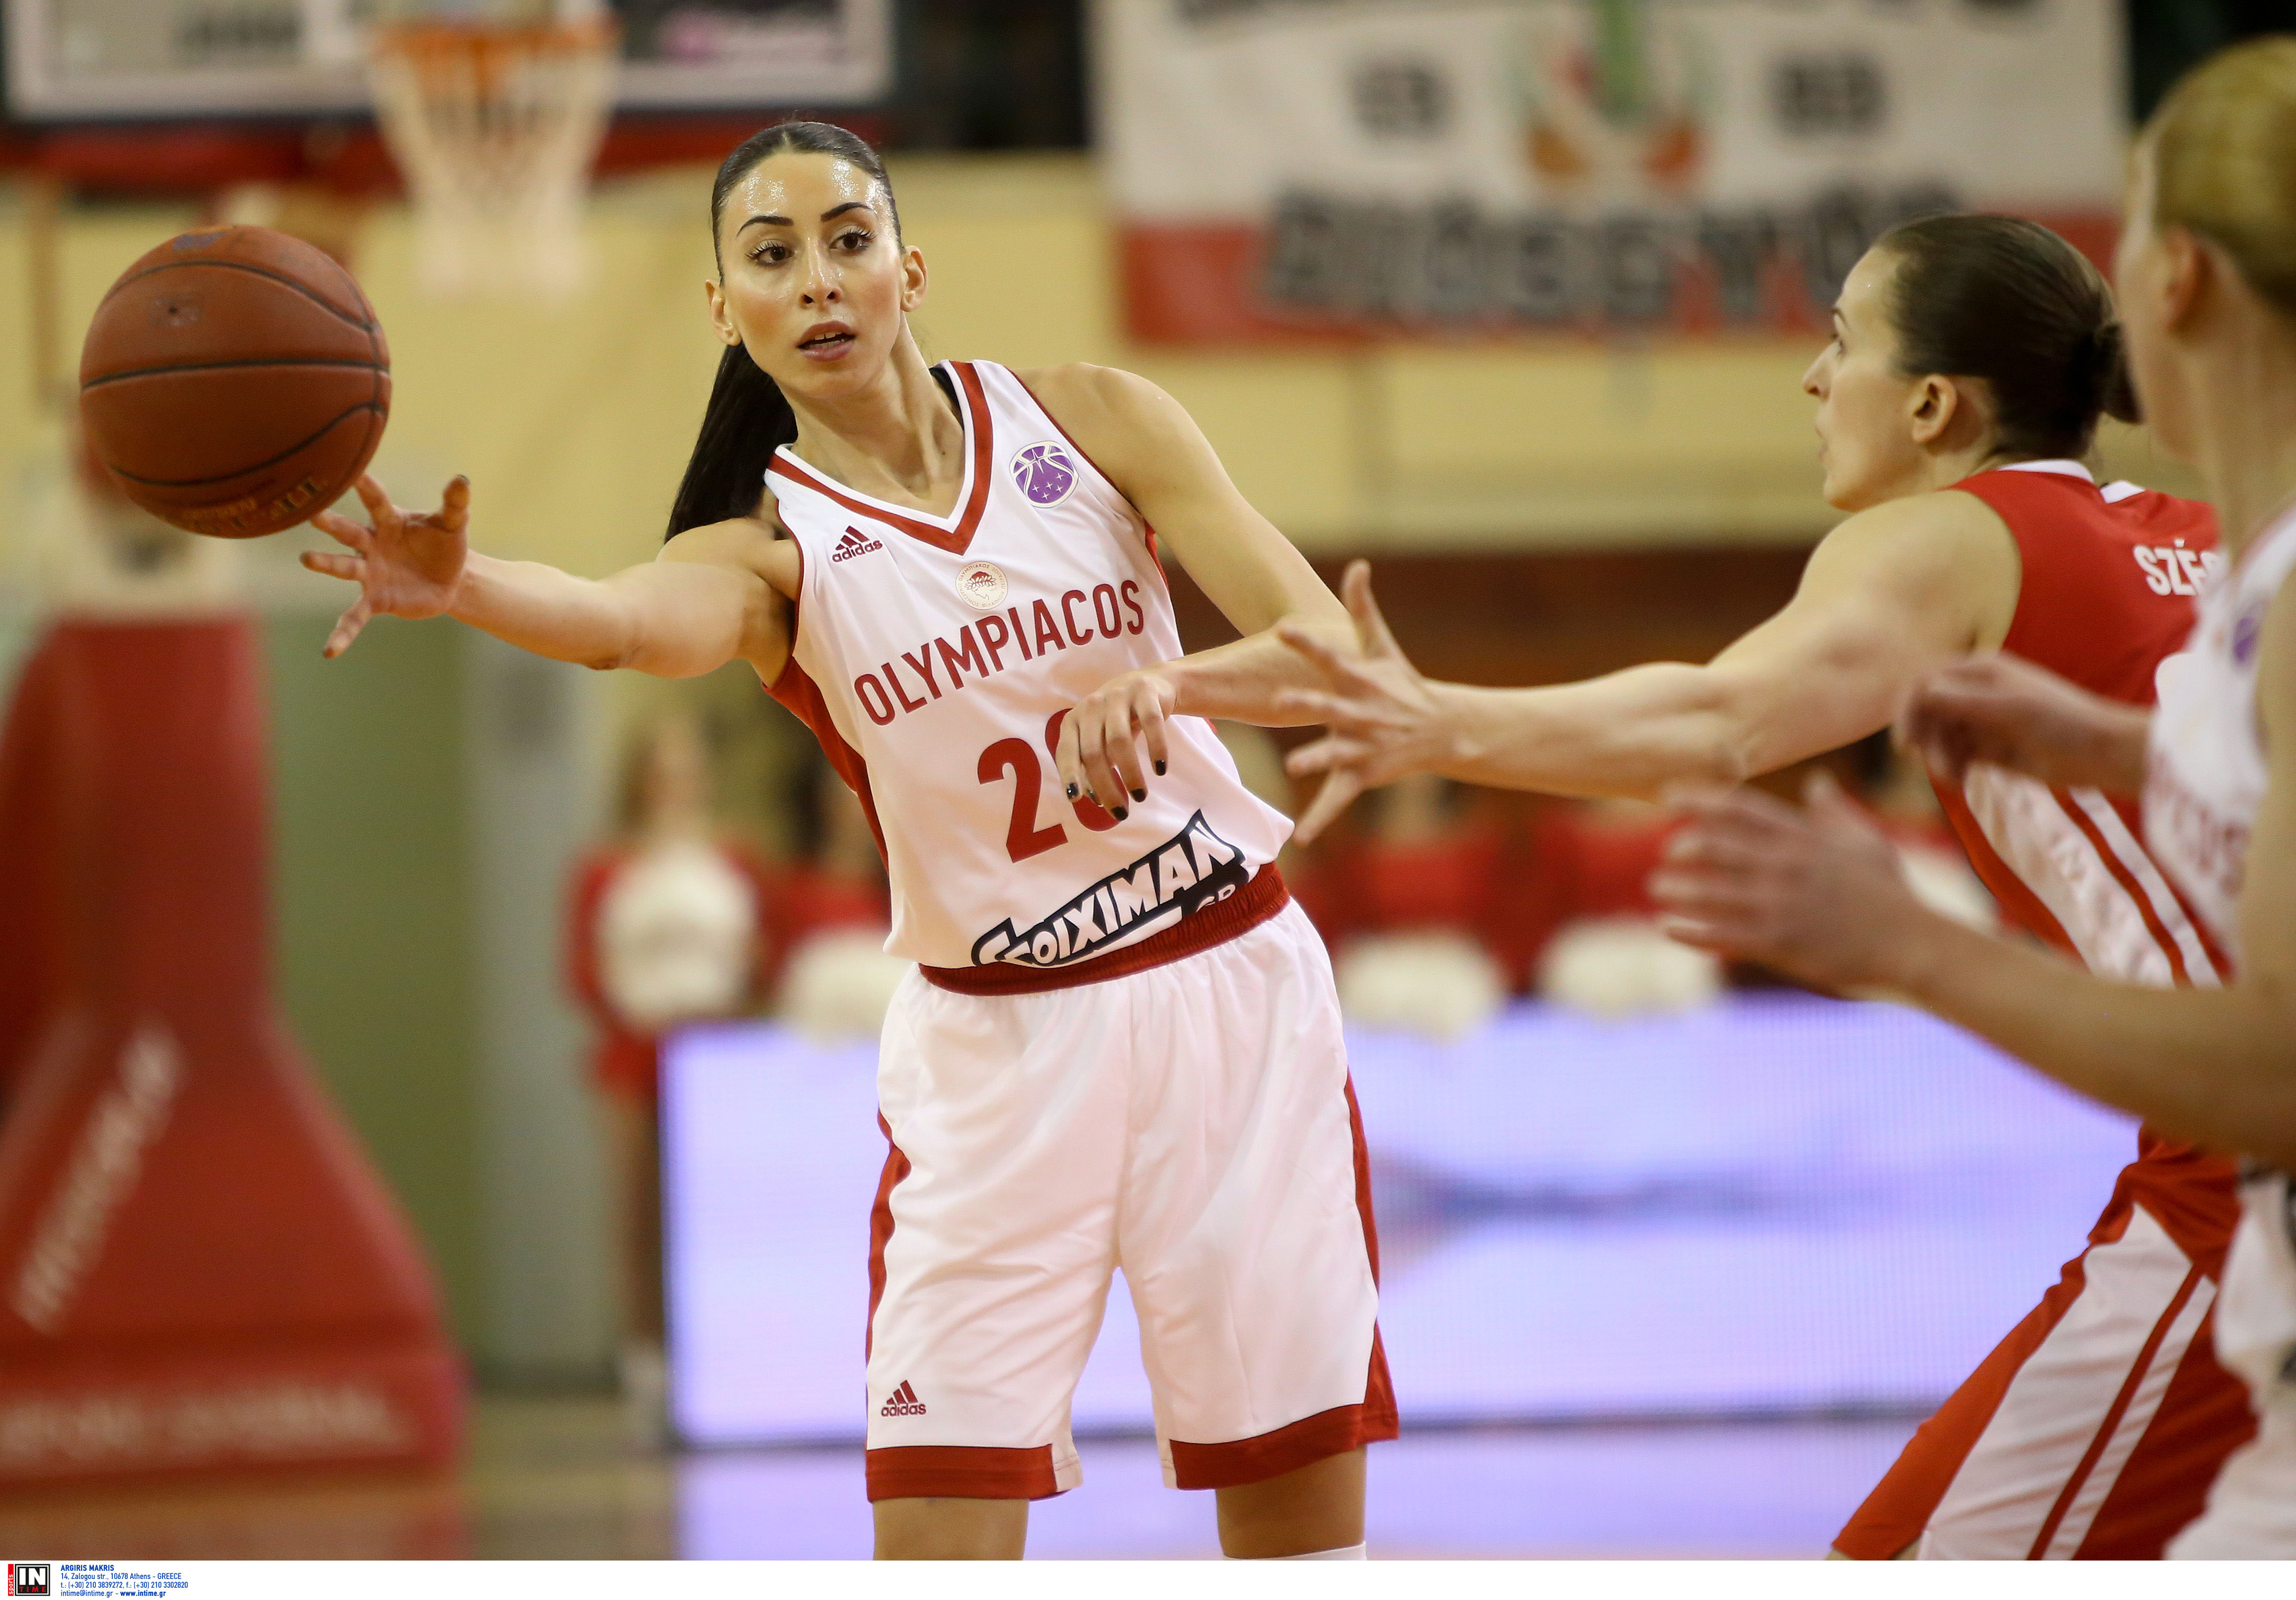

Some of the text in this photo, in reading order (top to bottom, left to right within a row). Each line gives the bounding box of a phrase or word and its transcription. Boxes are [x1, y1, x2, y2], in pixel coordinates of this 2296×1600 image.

[832, 540, 883, 562] adidas
[854, 580, 1144, 726] OLYMPIACOS
[881, 1403, 926, 1417] adidas
